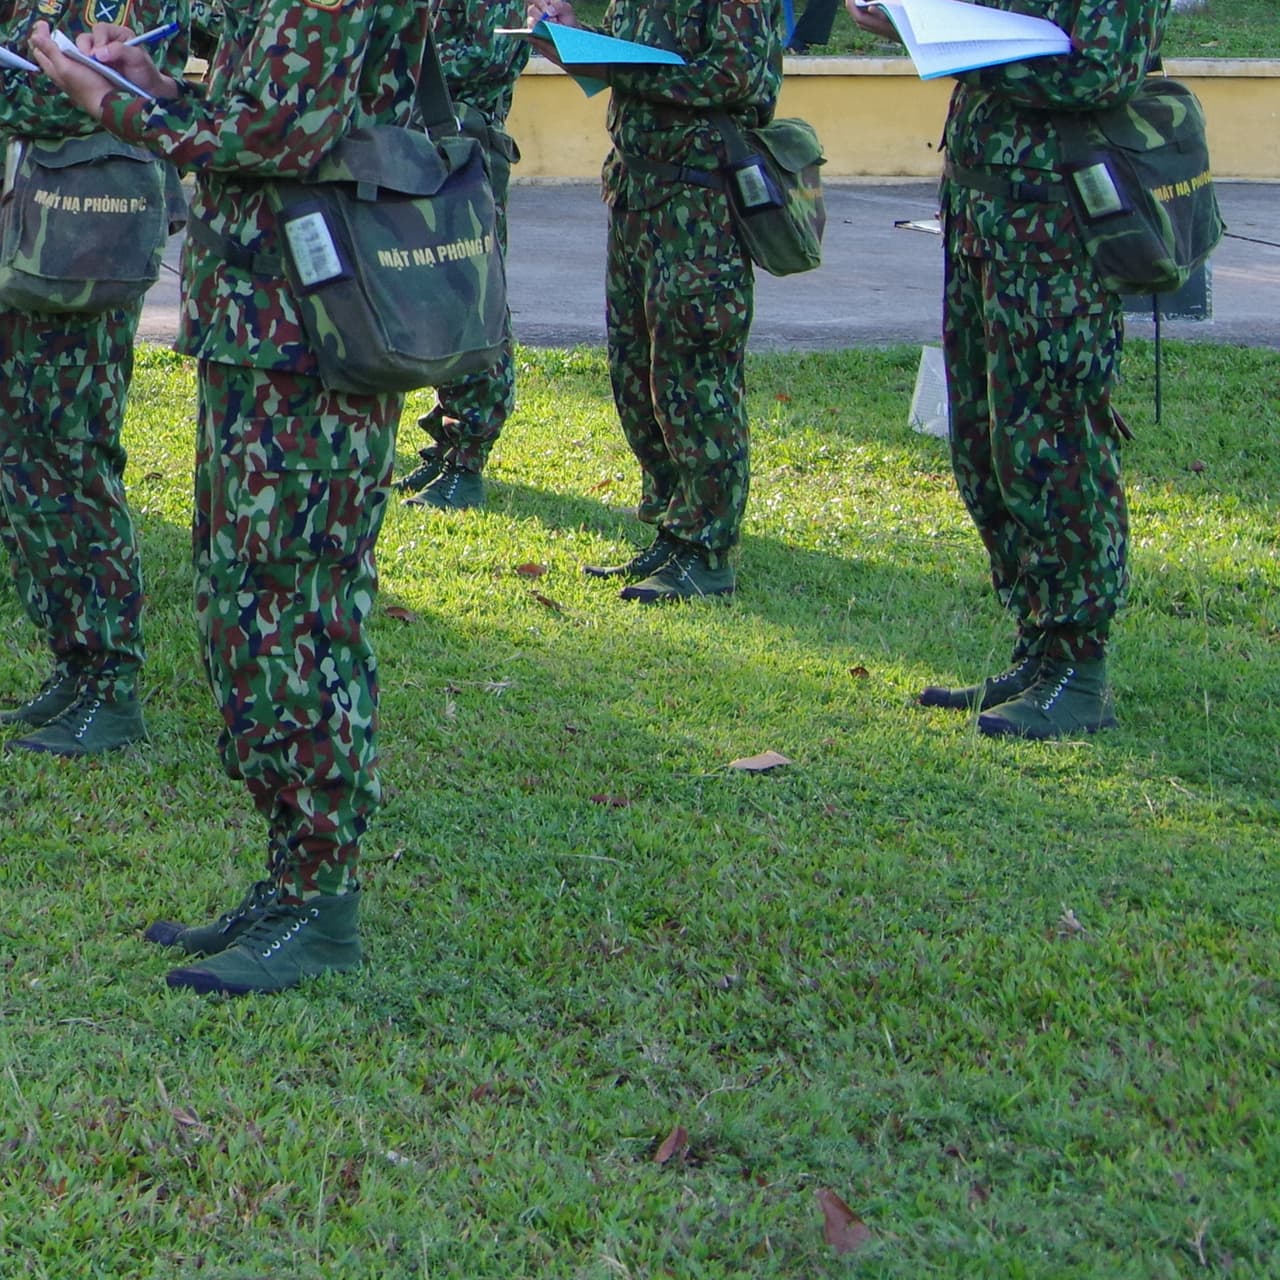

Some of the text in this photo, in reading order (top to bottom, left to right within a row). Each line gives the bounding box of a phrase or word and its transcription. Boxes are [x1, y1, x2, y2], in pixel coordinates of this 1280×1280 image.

[62, 196, 81, 215] NẠ
[83, 194, 128, 213] PHÒNG
[377, 248, 410, 271] MẶT
[412, 247, 437, 268] NẠ
[437, 238, 483, 263] PHÒNG
